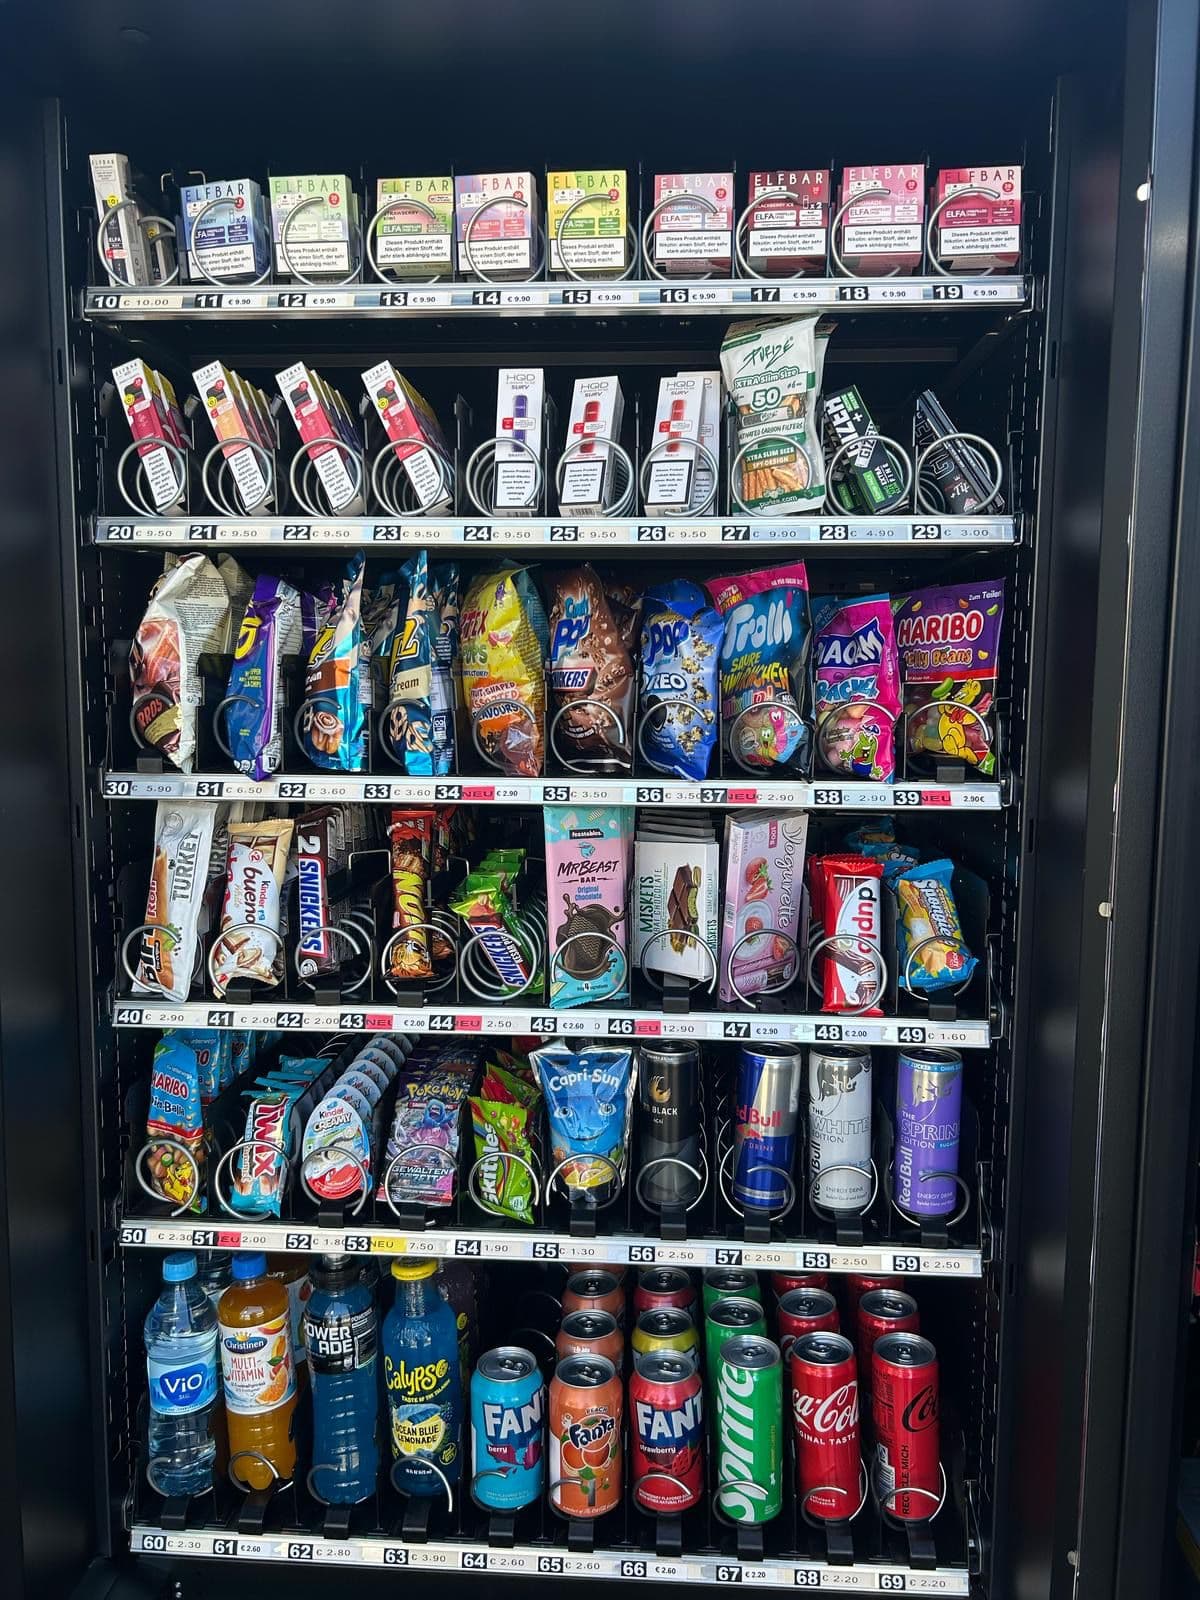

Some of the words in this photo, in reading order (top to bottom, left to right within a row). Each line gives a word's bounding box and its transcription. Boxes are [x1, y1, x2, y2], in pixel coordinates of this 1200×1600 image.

[754, 172, 823, 186] ELFBAR
[946, 169, 1015, 182] ELFBAR
[185, 184, 245, 201] ELFBAR
[381, 180, 449, 193] ELFBAR
[661, 213, 681, 223] ELFA
[475, 292, 498, 304] 14
[565, 291, 588, 303] 15
[663, 290, 686, 302] 16
[754, 289, 777, 301] 17
[842, 288, 866, 299] 18
[936, 286, 960, 298] 19
[95, 296, 117, 308] 10
[197, 295, 218, 307] 11
[281, 294, 303, 306] 12
[383, 293, 405, 305] 13
[752, 387, 781, 409] 50
[108, 526, 131, 539] 20
[191, 526, 212, 539] 21
[285, 526, 308, 539] 22
[375, 527, 398, 540] 23
[466, 527, 489, 541] 24
[552, 527, 575, 541] 25
[640, 527, 663, 540] 26
[724, 527, 747, 540] 27
[822, 526, 846, 539] 28
[914, 525, 939, 538] 29
[961, 529, 989, 537] 3.00
[723, 590, 793, 660] Trolli
[899, 612, 984, 647] HARIBO
[106, 782, 129, 795] 30
[198, 783, 219, 795] 31
[236, 786, 263, 794] 6.50
[281, 784, 304, 797] 32
[366, 785, 388, 798] 33
[437, 786, 460, 799] 34
[462, 789, 493, 798] NEU
[545, 787, 567, 800] 35
[581, 791, 608, 799] 3.50
[638, 789, 661, 801] 36
[703, 790, 725, 802] 37
[767, 793, 795, 802] 2.90
[817, 791, 840, 804] 38
[896, 792, 919, 804] 39
[171, 831, 201, 903] TURKEY
[774, 822, 803, 929] Yogurette
[243, 866, 263, 924] bueno
[258, 880, 271, 909] kinder
[577, 885, 599, 893] Original
[639, 876, 654, 933] MISKETS
[852, 887, 877, 954] duplo
[118, 1010, 140, 1023] 40
[209, 1012, 229, 1025] 41
[278, 1013, 300, 1027] 42
[341, 1014, 363, 1028] 43
[430, 1016, 453, 1029] 44
[532, 1018, 555, 1031] 45
[610, 1020, 632, 1033] 46
[725, 1023, 748, 1036] 47
[817, 1025, 840, 1039] 48
[900, 1028, 923, 1042] 49
[549, 1068, 621, 1092] Capri-Sun
[651, 1105, 678, 1117] BLACK
[812, 1106, 824, 1115] THE
[902, 1110, 916, 1120] THE
[313, 1113, 353, 1132] CREAMY
[813, 1118, 870, 1135] WHITE
[901, 1118, 960, 1141] SPRIN
[901, 1136, 936, 1149] EDITION
[899, 1145, 913, 1179] Bull
[898, 1181, 912, 1207] Red
[122, 1229, 143, 1243] 50
[194, 1232, 214, 1245] 51
[288, 1235, 309, 1248] 52
[347, 1237, 368, 1250] 53
[370, 1240, 395, 1249] NEU
[457, 1241, 479, 1255] 54
[535, 1244, 556, 1257] 55
[570, 1248, 595, 1256] 1.30
[631, 1247, 653, 1261] 56
[718, 1250, 740, 1264] 57
[805, 1253, 828, 1267] 58
[895, 1257, 918, 1271] 59
[934, 1261, 960, 1269] 2.50
[225, 1338, 265, 1351] Christinen
[318, 1339, 353, 1355] ADE
[229, 1368, 265, 1381] VITAMIN
[384, 1355, 450, 1396] Calypso
[585, 1406, 608, 1415] PEACH
[394, 1426, 418, 1436] OCEAN
[419, 1424, 440, 1436] BLUE
[569, 1416, 615, 1448] Fanta
[397, 1434, 437, 1444] LEMONADE
[829, 1431, 856, 1445] TASTE
[487, 1445, 508, 1454] berry
[639, 1444, 676, 1455] strawberry
[902, 1444, 910, 1471] MICH
[144, 1536, 164, 1550] 60
[215, 1540, 234, 1554] 61
[246, 1545, 261, 1553] 2.60
[290, 1544, 311, 1558] 62
[386, 1549, 406, 1563] 63
[422, 1554, 447, 1563] 3.90
[464, 1553, 485, 1567] 64
[540, 1558, 561, 1572] 65
[623, 1562, 644, 1576] 66
[662, 1567, 677, 1575] 2.60
[718, 1567, 740, 1581] 67
[751, 1571, 766, 1579] 2.20
[796, 1570, 818, 1585] 68
[881, 1575, 903, 1589] 69
